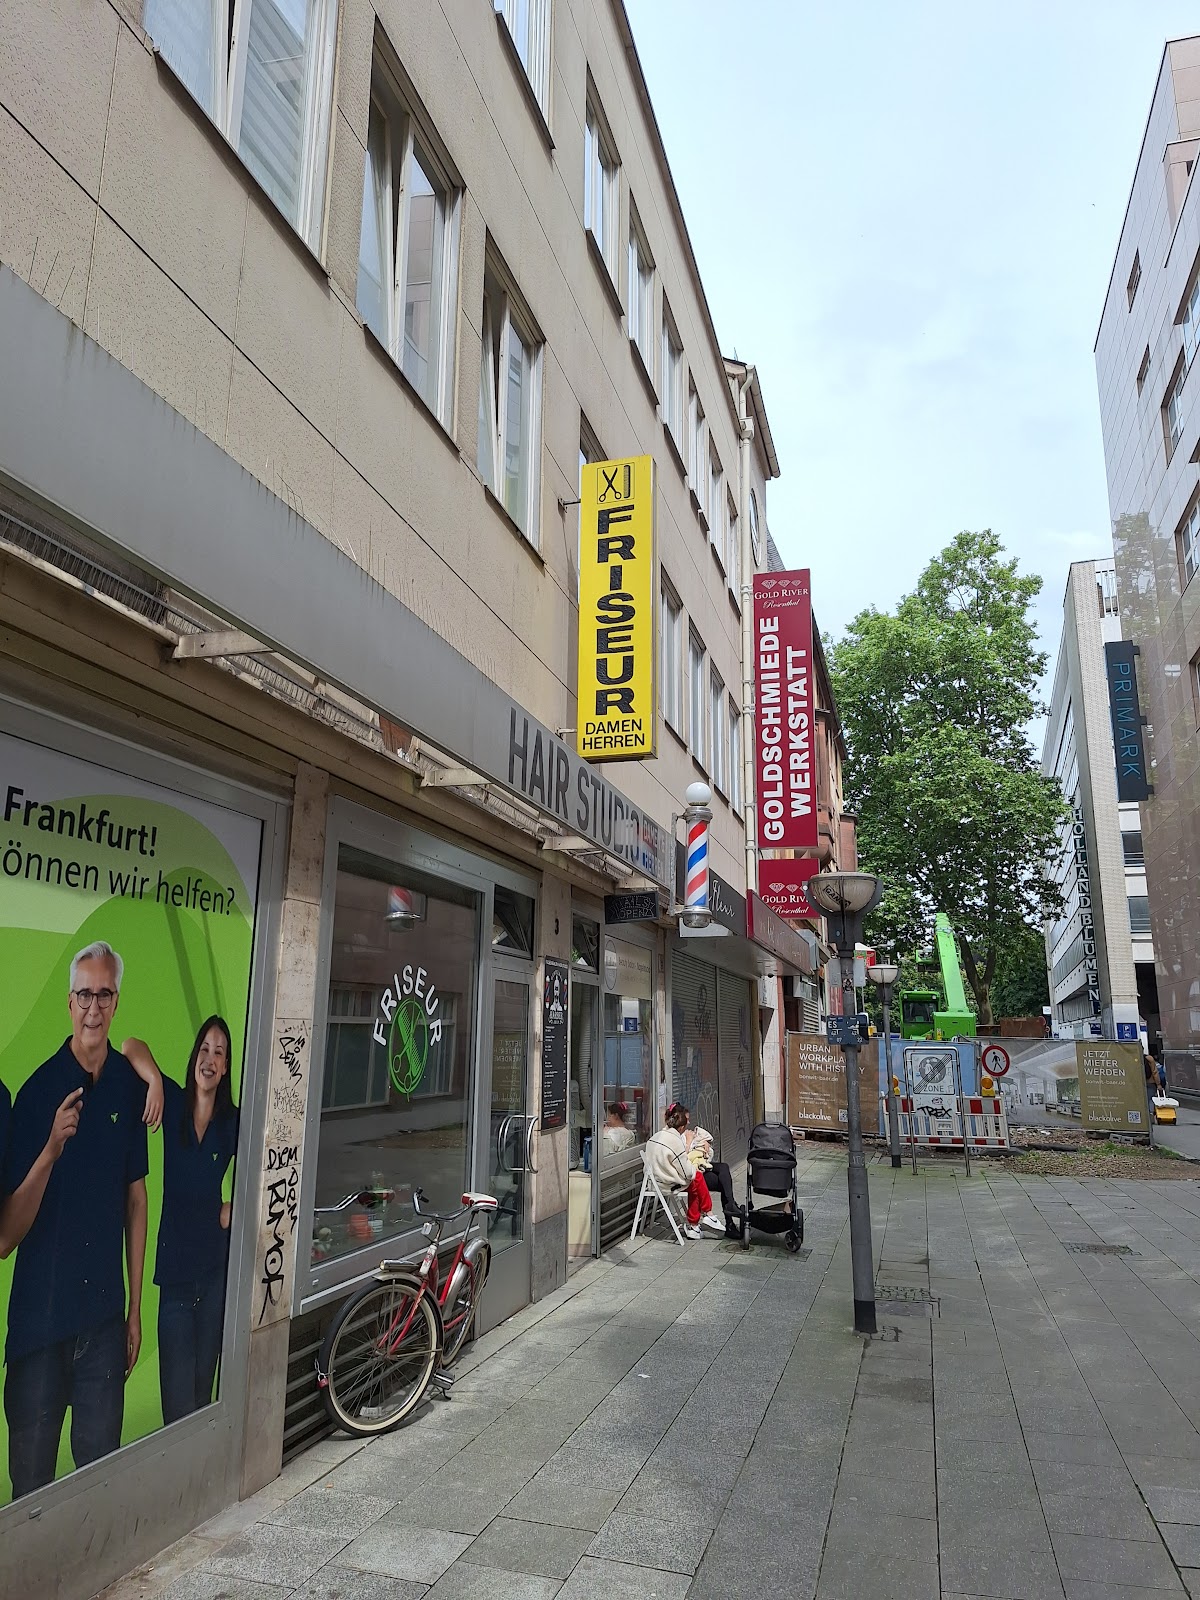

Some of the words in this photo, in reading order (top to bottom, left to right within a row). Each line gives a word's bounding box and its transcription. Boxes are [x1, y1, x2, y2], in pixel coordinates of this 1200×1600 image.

[754, 590, 780, 600] GOLD
[781, 588, 809, 599] RIVER
[595, 504, 637, 716] FRISEUR
[585, 718, 643, 735] DAMEN
[1112, 662, 1141, 777] PRIMARK
[760, 616, 785, 841] GOLDSCHMIEDE
[786, 645, 811, 818] WERKSTATT
[582, 733, 645, 751] HERREN
[508, 706, 570, 820] HAIR
[576, 766, 640, 862] STUDIO
[4, 785, 158, 857] Frankfurt!
[0, 839, 100, 892] önnen
[108, 866, 150, 900] wir
[156, 869, 236, 916] helfen?
[761, 894, 788, 904] GOLD
[771, 906, 810, 915] Rosenthal
[554, 918, 560, 936] 3
[373, 965, 442, 1046] FRISEUR
[799, 1043, 831, 1053] URBAN
[1083, 1050, 1110, 1058] JETZT
[799, 1053, 847, 1064] WORKPLA
[1083, 1059, 1118, 1068] MIETER
[799, 1062, 823, 1072] WITH
[825, 1064, 865, 1075] HISTY
[1084, 1068, 1126, 1077] WERDEN
[923, 1084, 945, 1093] ZONE
[799, 1107, 832, 1121] blackolive
[1088, 1110, 1122, 1123] blackolive
